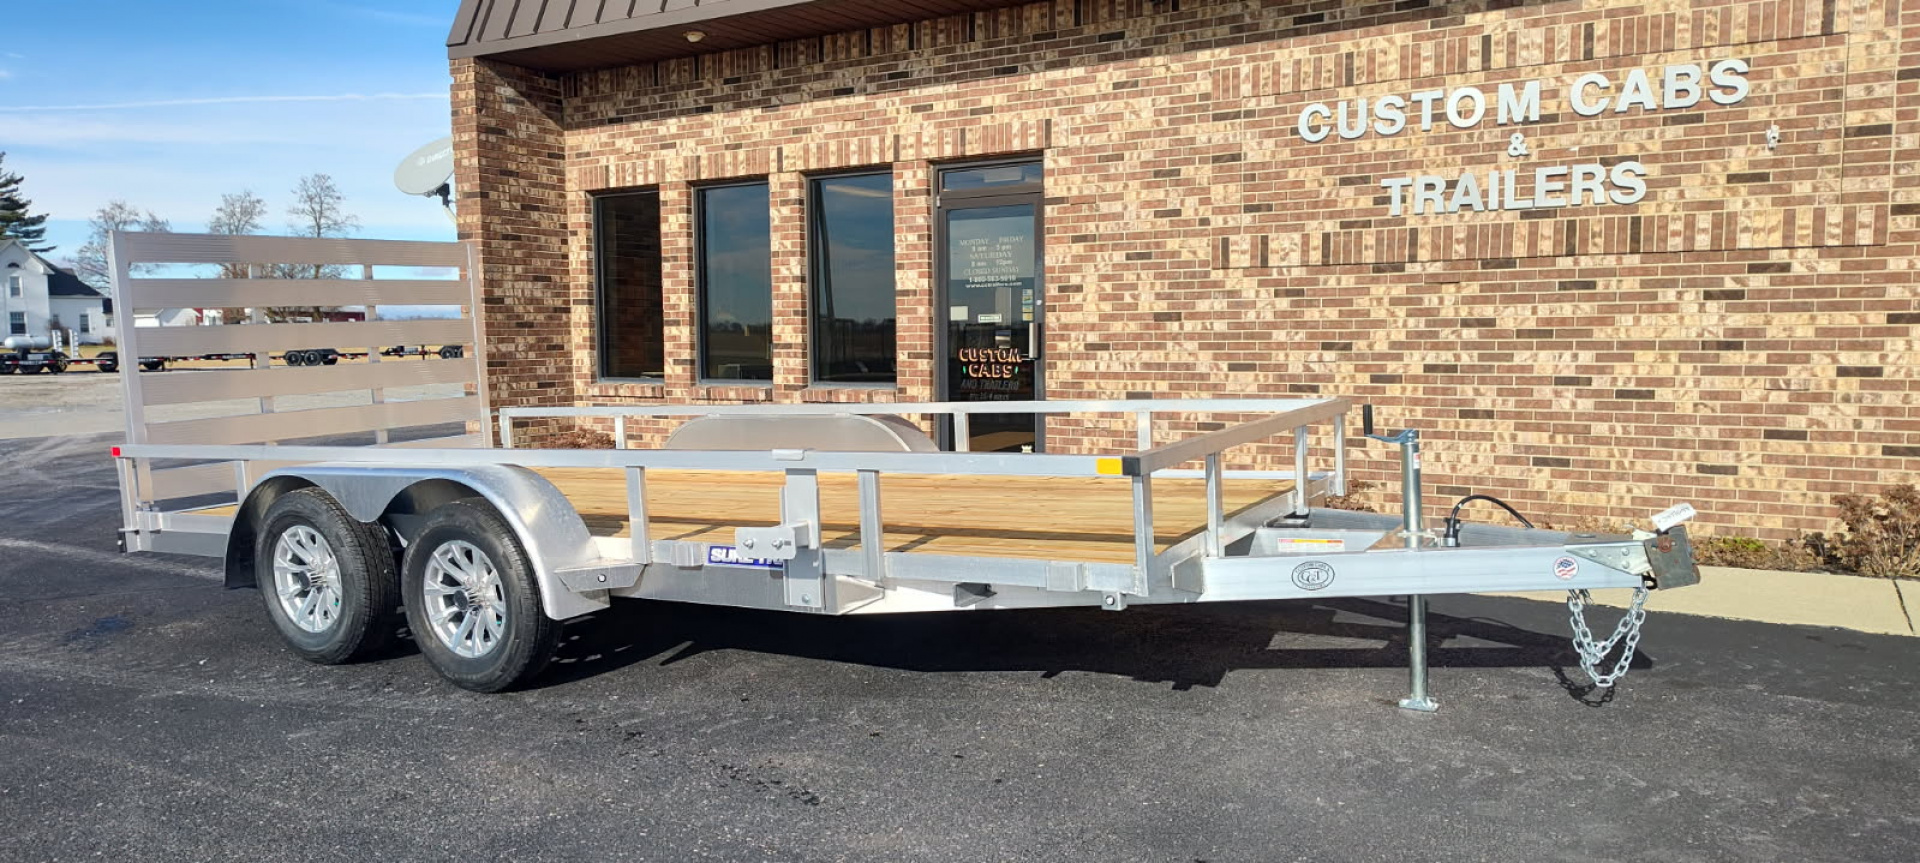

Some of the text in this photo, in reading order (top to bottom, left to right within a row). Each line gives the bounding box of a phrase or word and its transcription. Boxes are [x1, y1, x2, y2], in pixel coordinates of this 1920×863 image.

[1298, 59, 1749, 143] CUSTOM CABS
[1507, 132, 1530, 157] &
[1381, 161, 1647, 217] TRAILERS
[960, 234, 1024, 247] MONDAY FRIDAY
[970, 251, 1012, 259] SATURDAY
[963, 266, 1019, 276] CLOSED SUNDAY
[959, 348, 1022, 363] CUSTOM
[968, 364, 1012, 378] CABS
